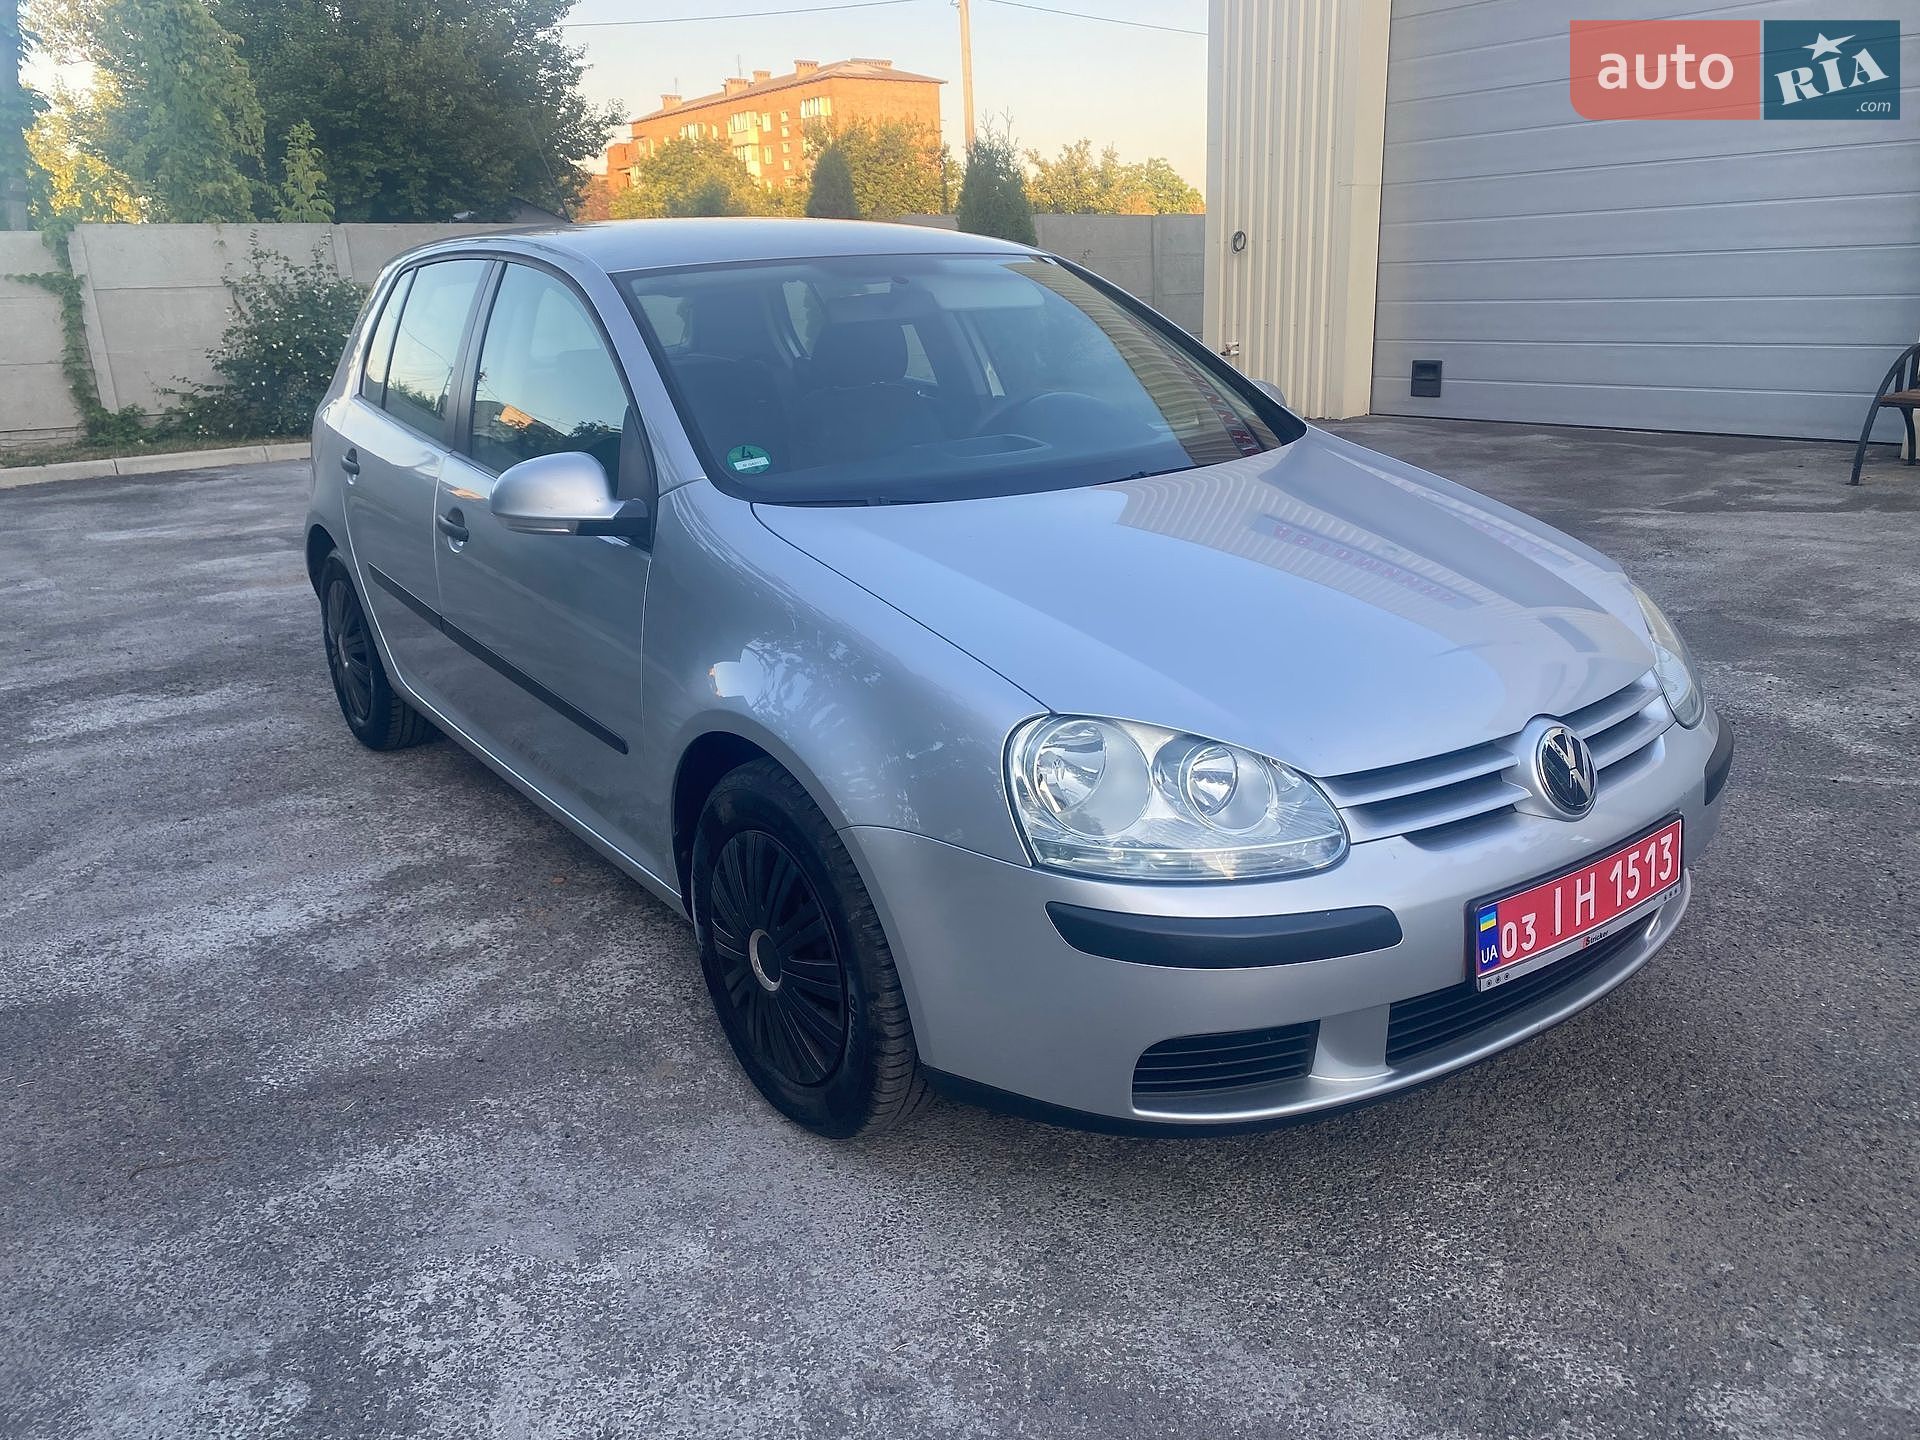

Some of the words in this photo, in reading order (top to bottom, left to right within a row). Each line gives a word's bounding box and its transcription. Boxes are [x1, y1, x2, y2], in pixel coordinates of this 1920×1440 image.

[1501, 912, 1537, 959] 03
[1554, 872, 1596, 936] IH
[1609, 832, 1673, 907] 1513
[1481, 944, 1498, 964] UA
